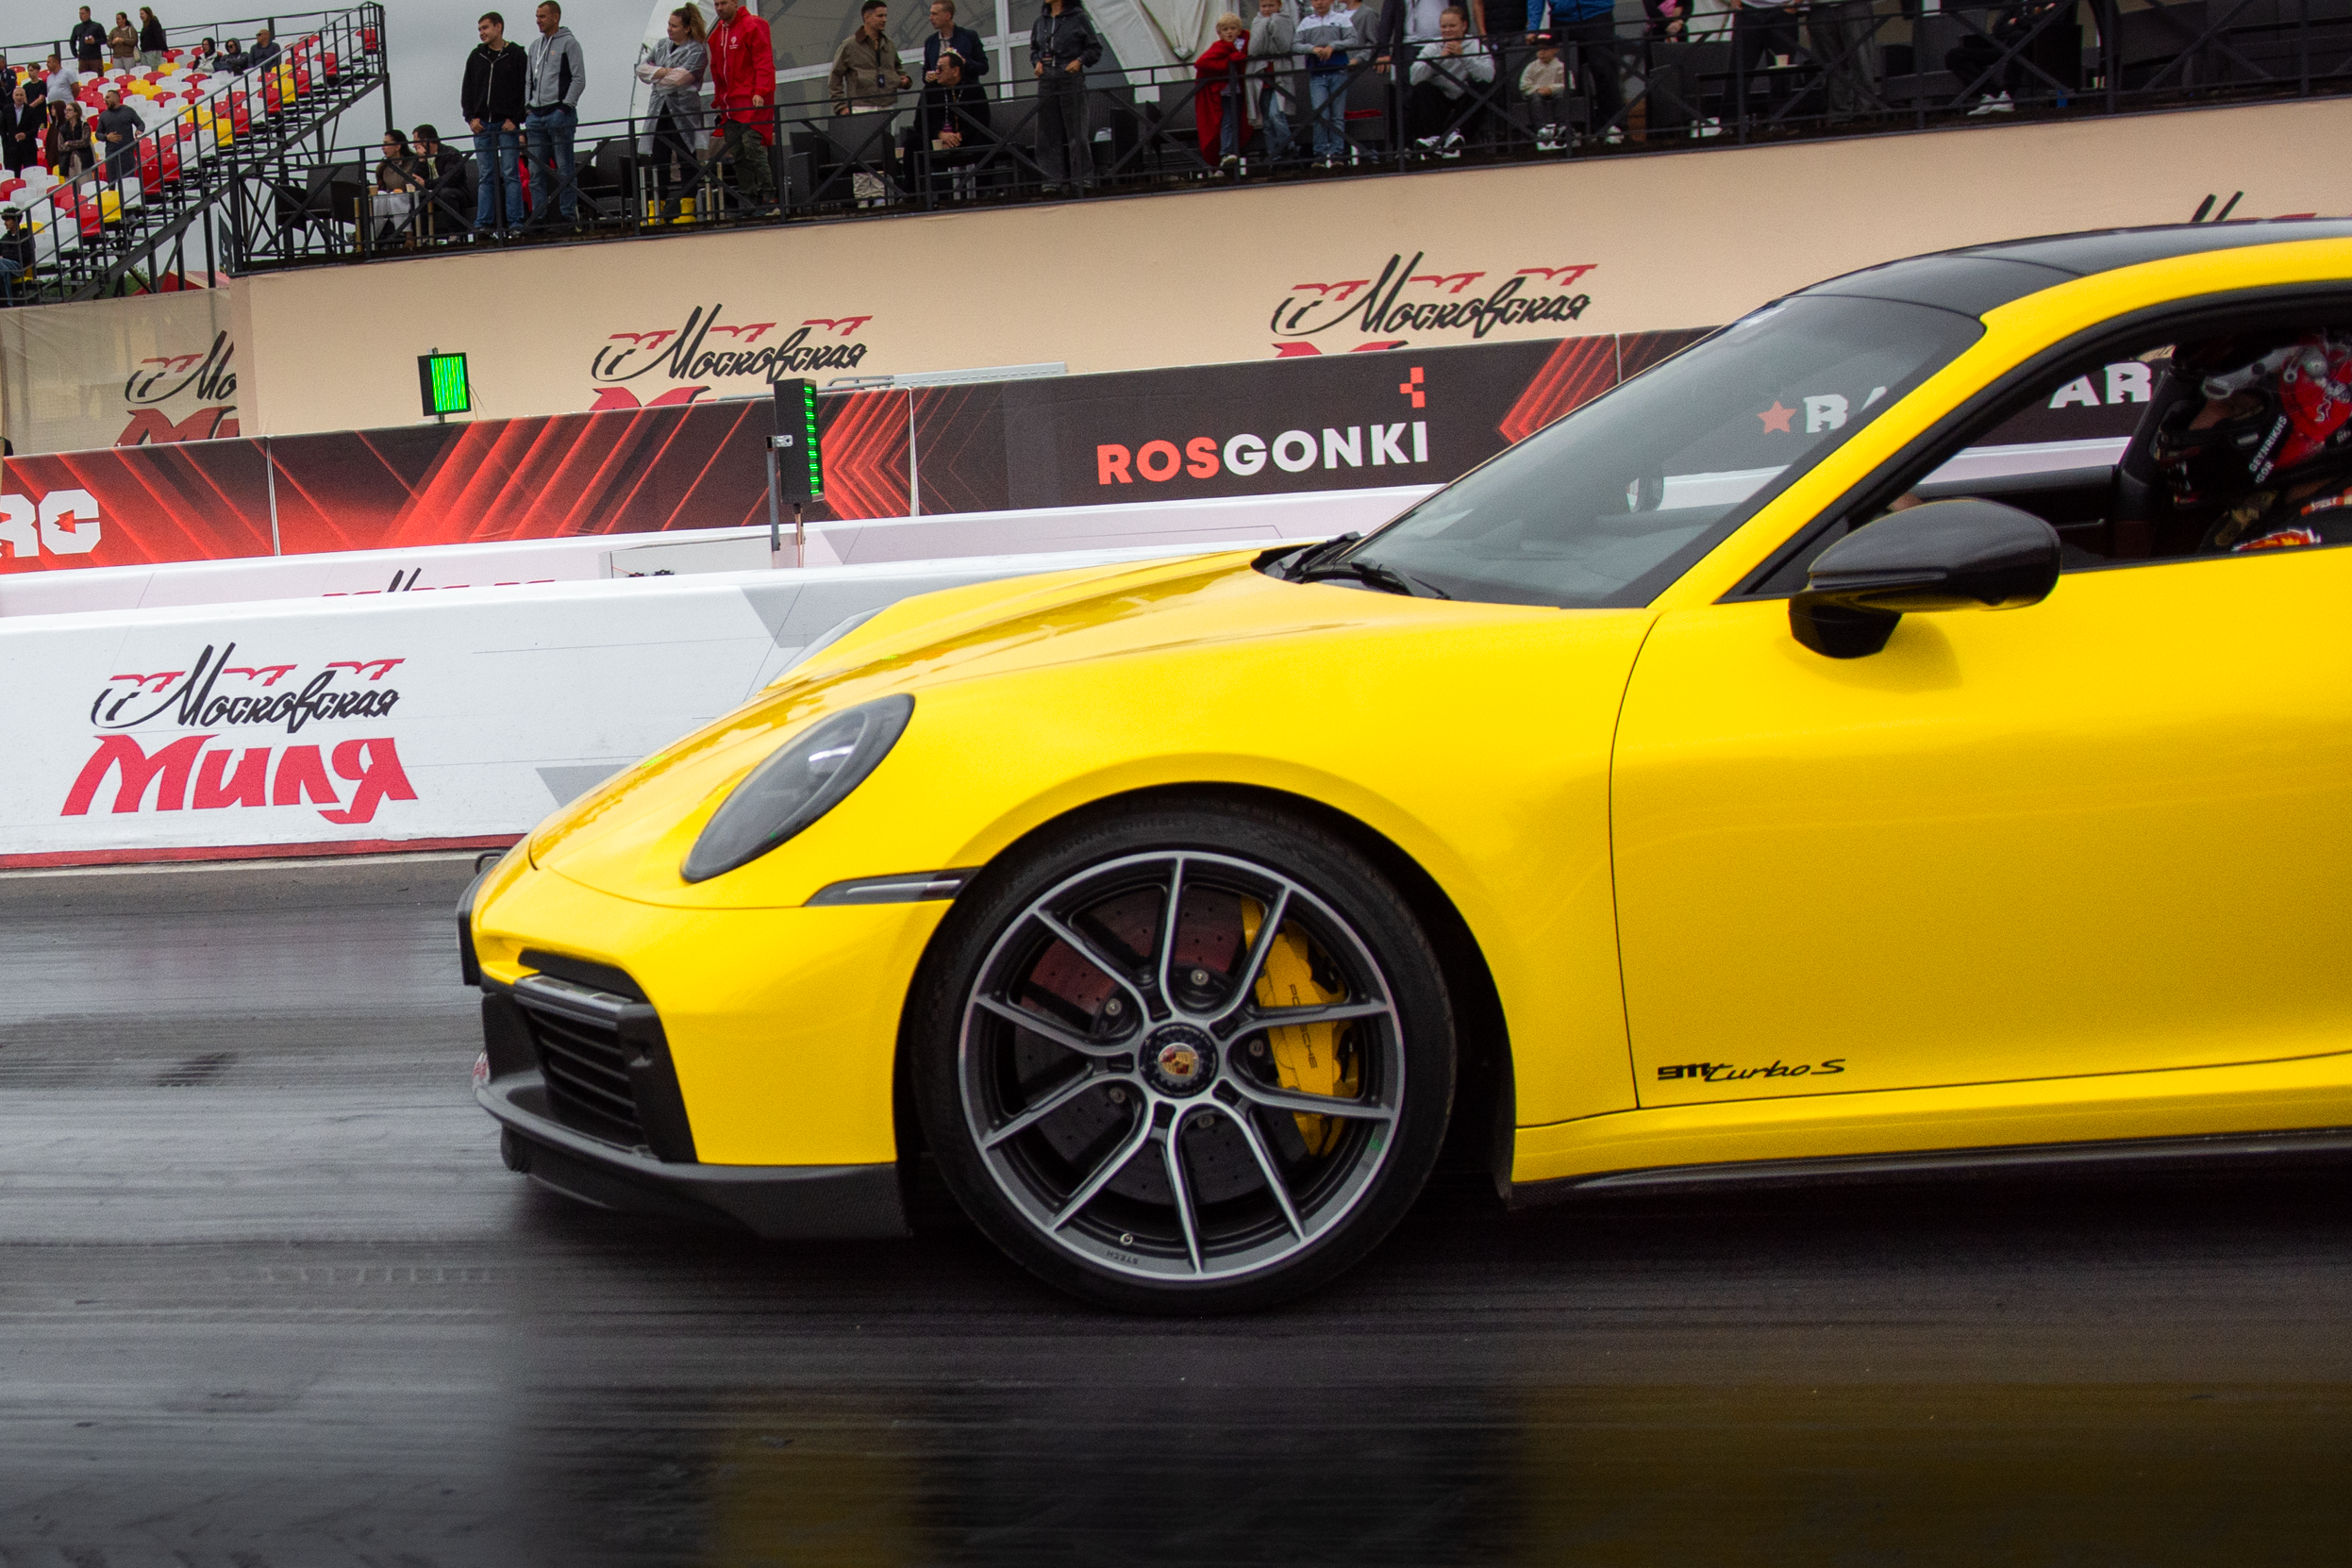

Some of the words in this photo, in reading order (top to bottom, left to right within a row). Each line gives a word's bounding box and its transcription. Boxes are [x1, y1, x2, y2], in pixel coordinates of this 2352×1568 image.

[1271, 251, 1592, 339] Московская
[591, 303, 868, 385] Московская
[1096, 421, 1428, 485] ROSGONKI
[2255, 460, 2275, 484] IGOR
[91, 642, 400, 733] Московская
[59, 734, 418, 825] Миля
[1704, 1059, 1811, 1083] turbo
[1810, 1059, 1846, 1075] S
